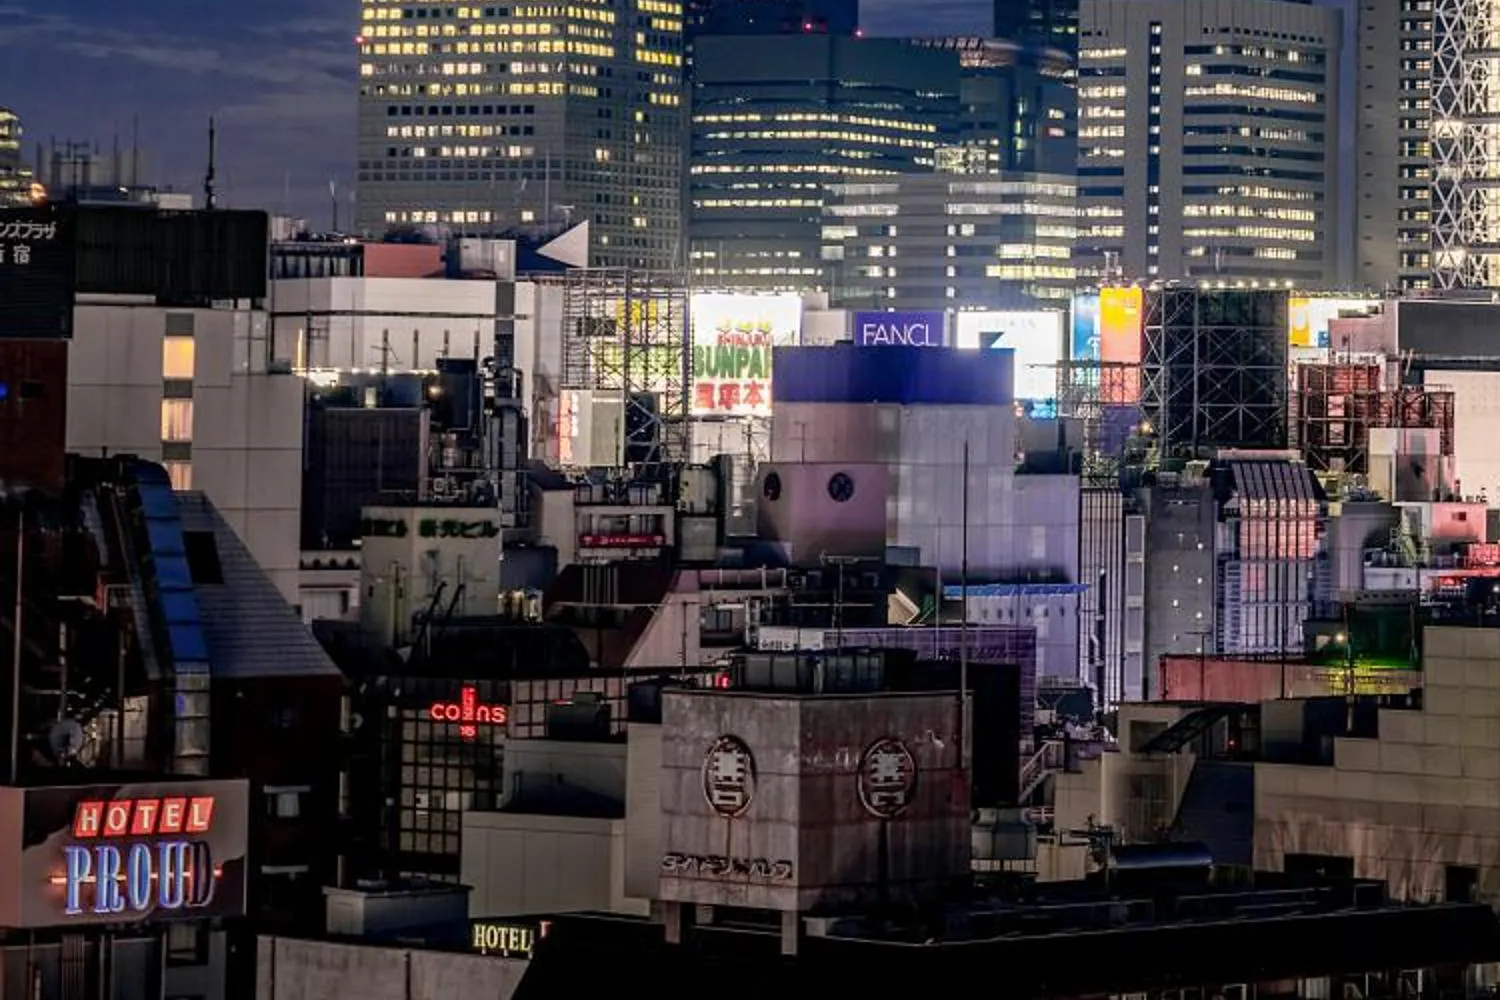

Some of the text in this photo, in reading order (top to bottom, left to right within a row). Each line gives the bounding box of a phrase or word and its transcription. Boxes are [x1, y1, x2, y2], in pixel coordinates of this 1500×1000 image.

[863, 323, 939, 347] FANCL
[79, 802, 208, 832] HOTEL
[64, 839, 215, 915] PROUD
[473, 924, 532, 951] HOTEL
